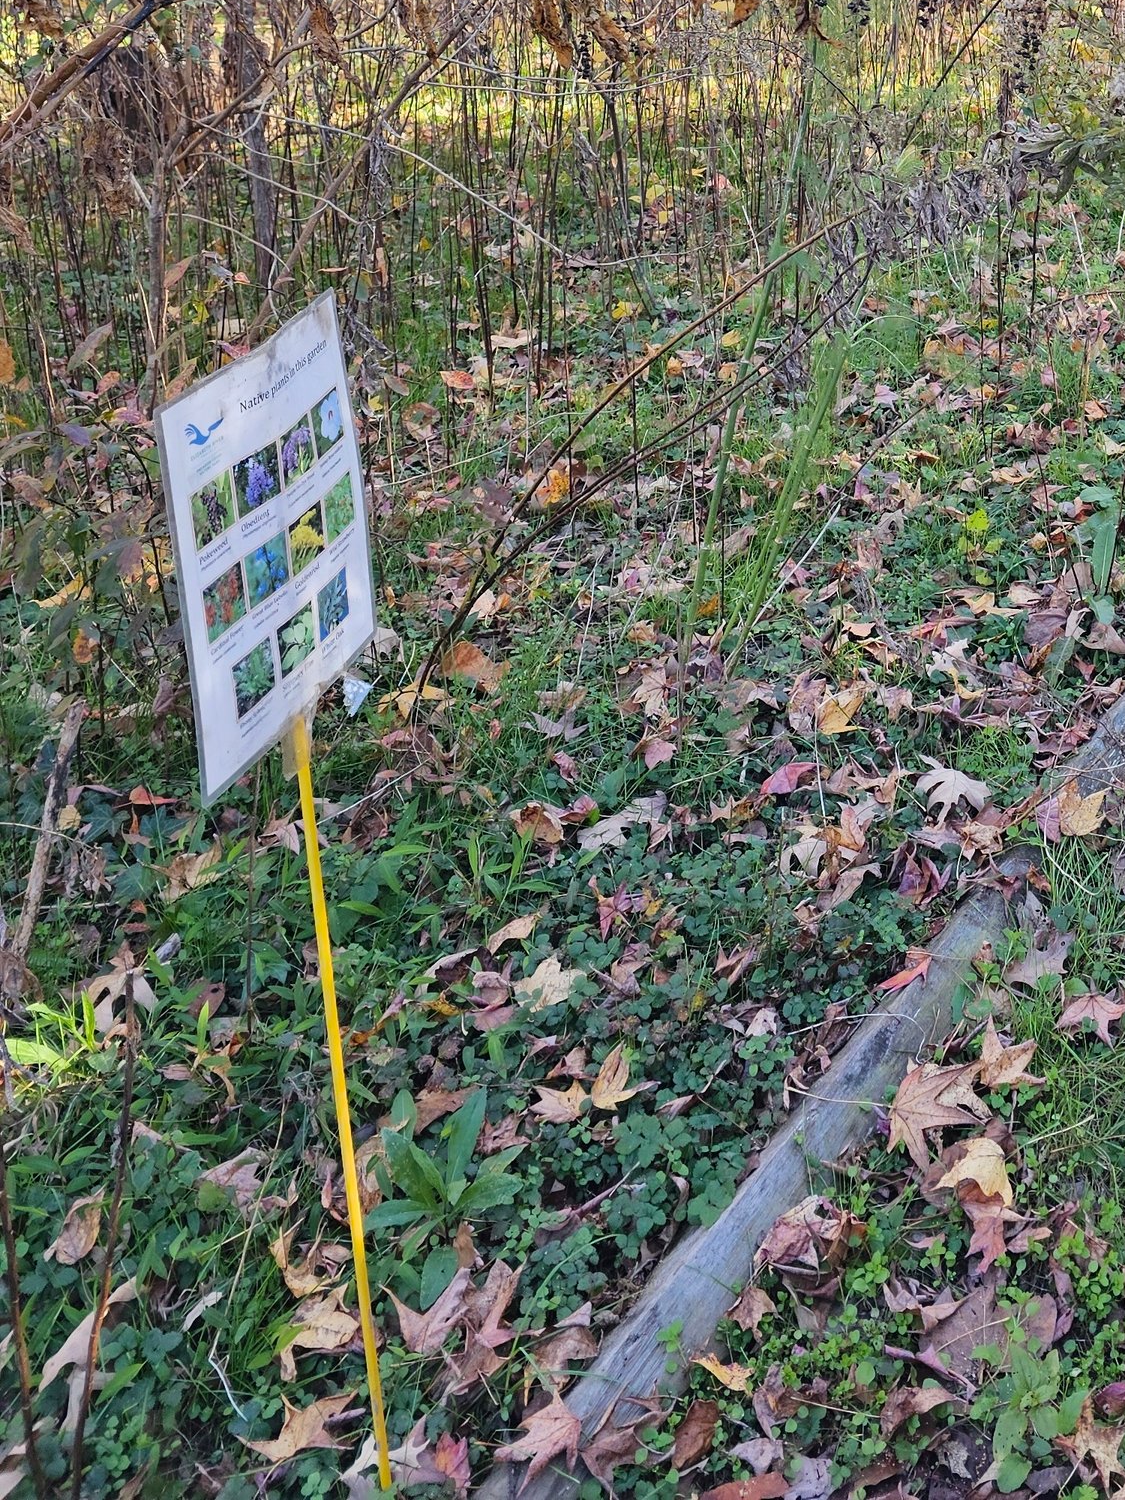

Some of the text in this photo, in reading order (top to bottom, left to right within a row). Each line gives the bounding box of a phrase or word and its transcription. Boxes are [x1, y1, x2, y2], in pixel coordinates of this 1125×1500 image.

[239, 339, 328, 413] Native plants in this garden
[199, 536, 229, 566] Pokeweed
[294, 562, 320, 590] Goldenrod
